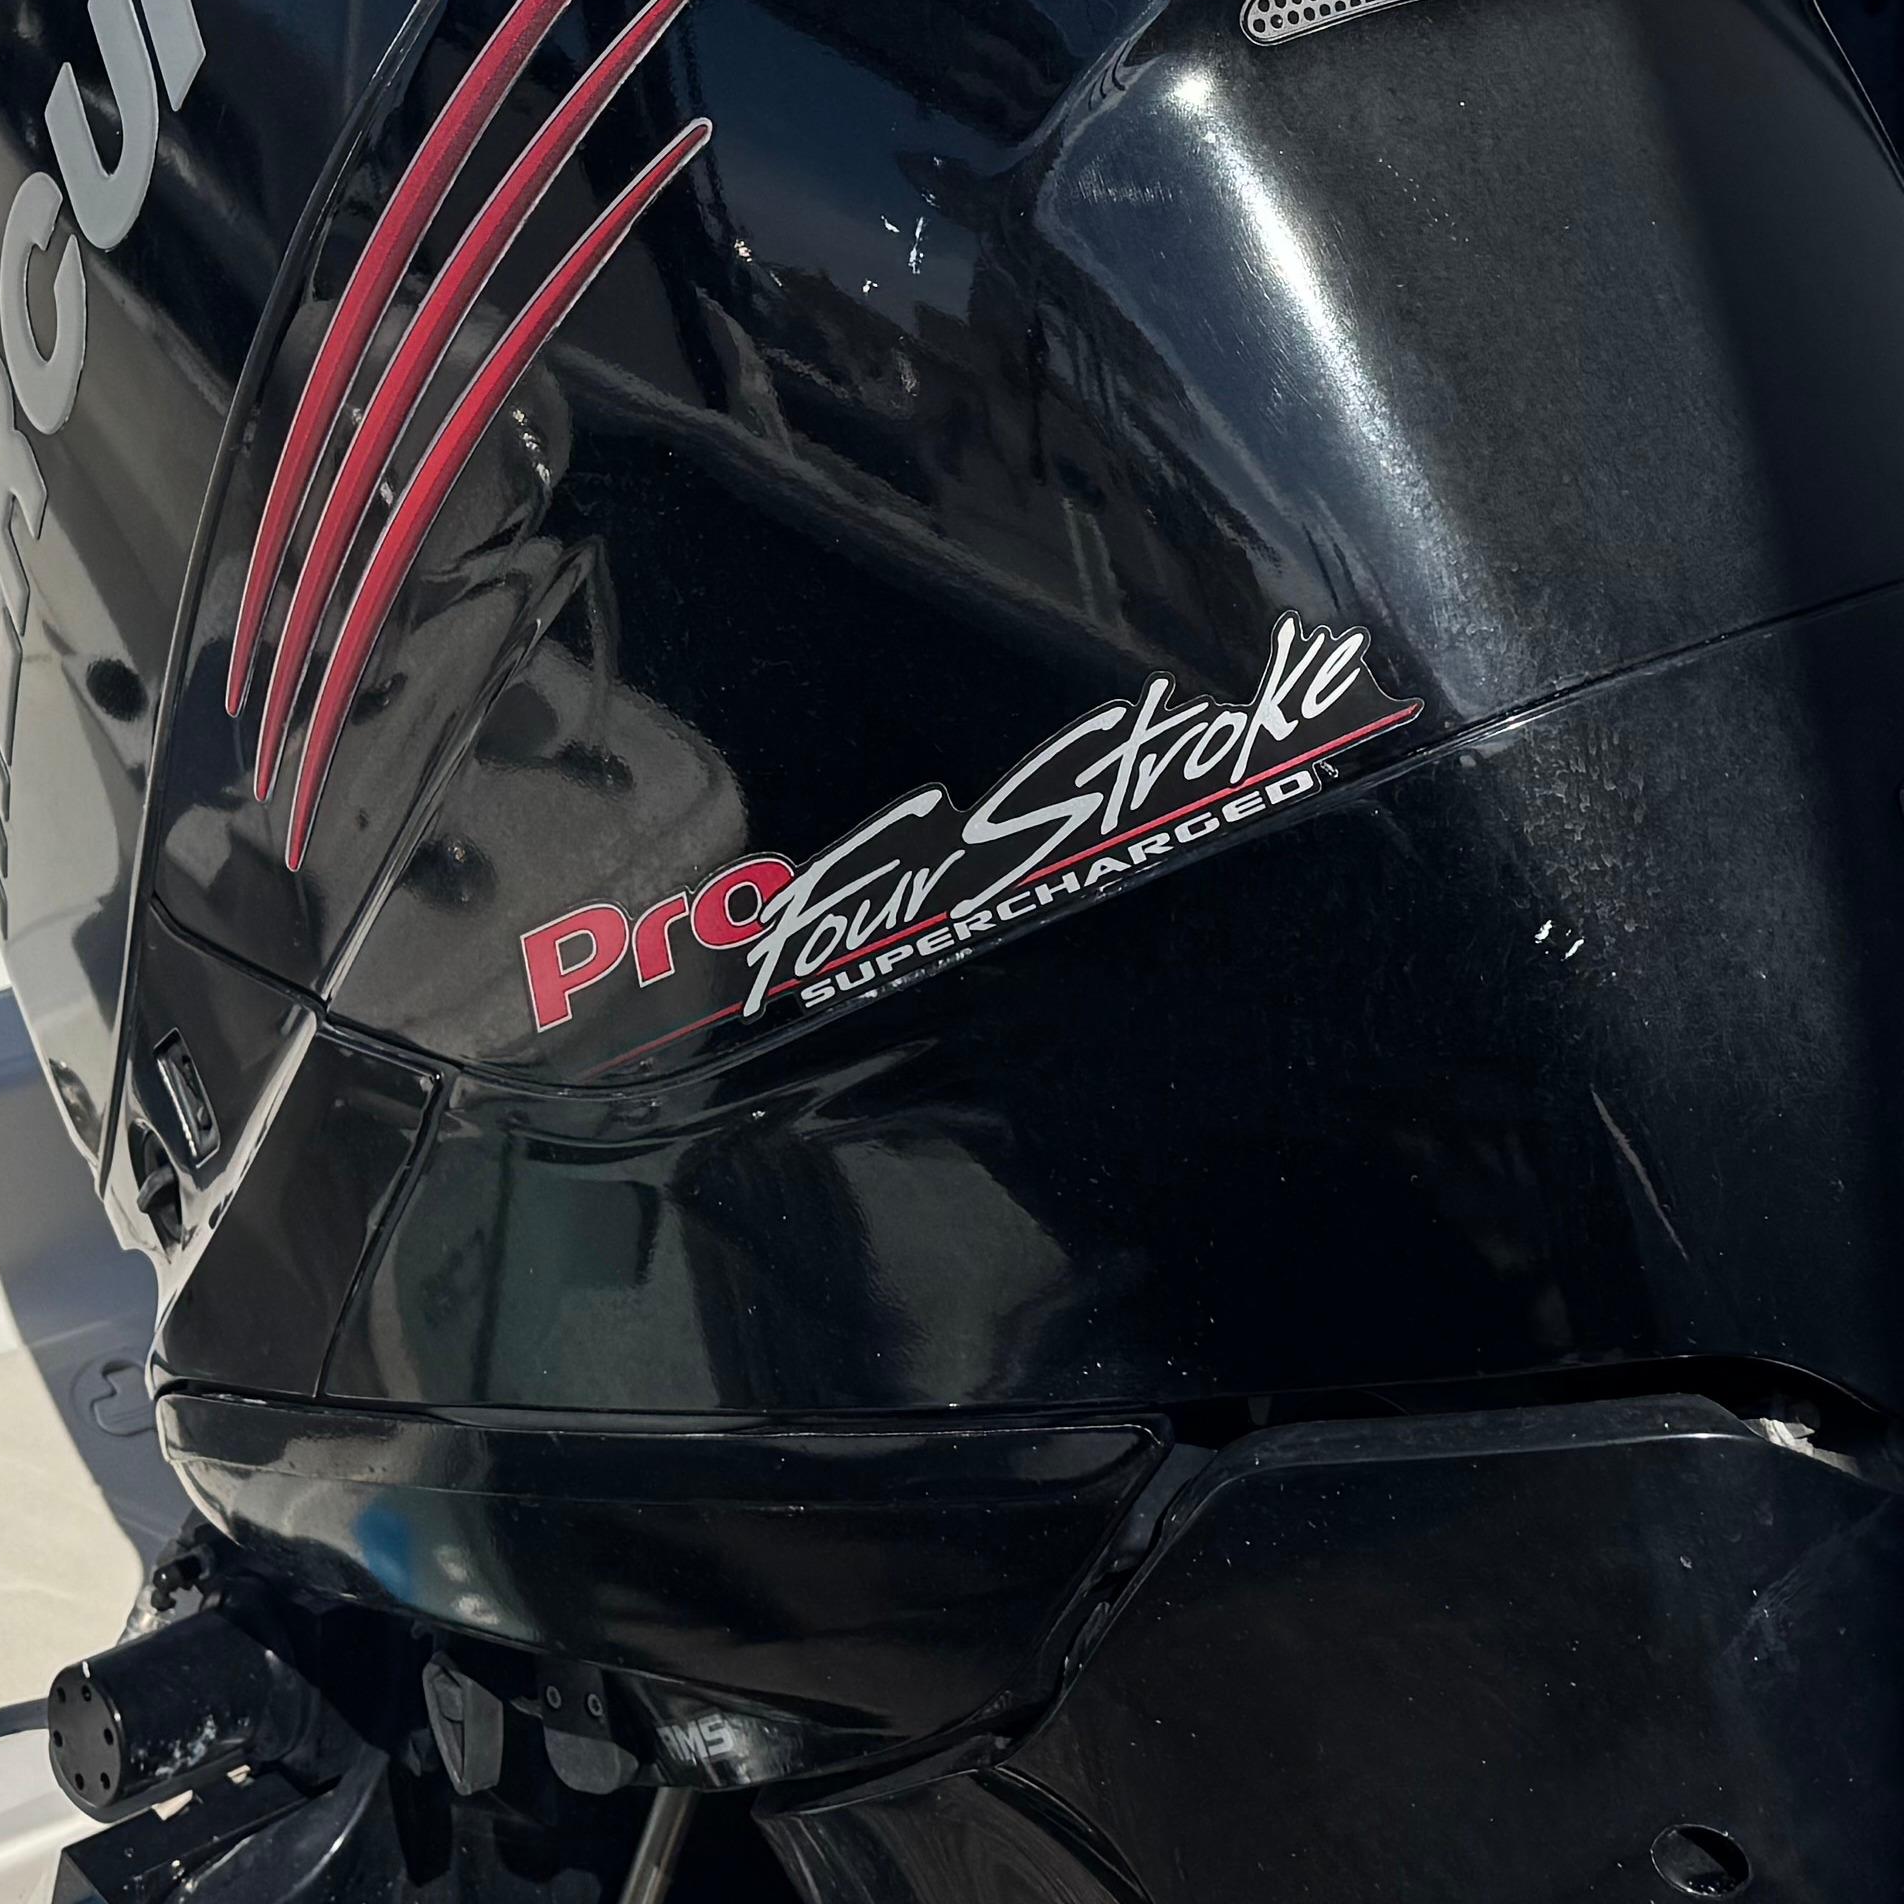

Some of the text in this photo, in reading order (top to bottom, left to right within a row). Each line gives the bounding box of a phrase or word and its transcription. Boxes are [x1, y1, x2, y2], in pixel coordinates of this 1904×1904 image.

[519, 613, 1364, 1033] Pro Four Stroke
[801, 771, 1314, 1010] SUPERCHARGED
